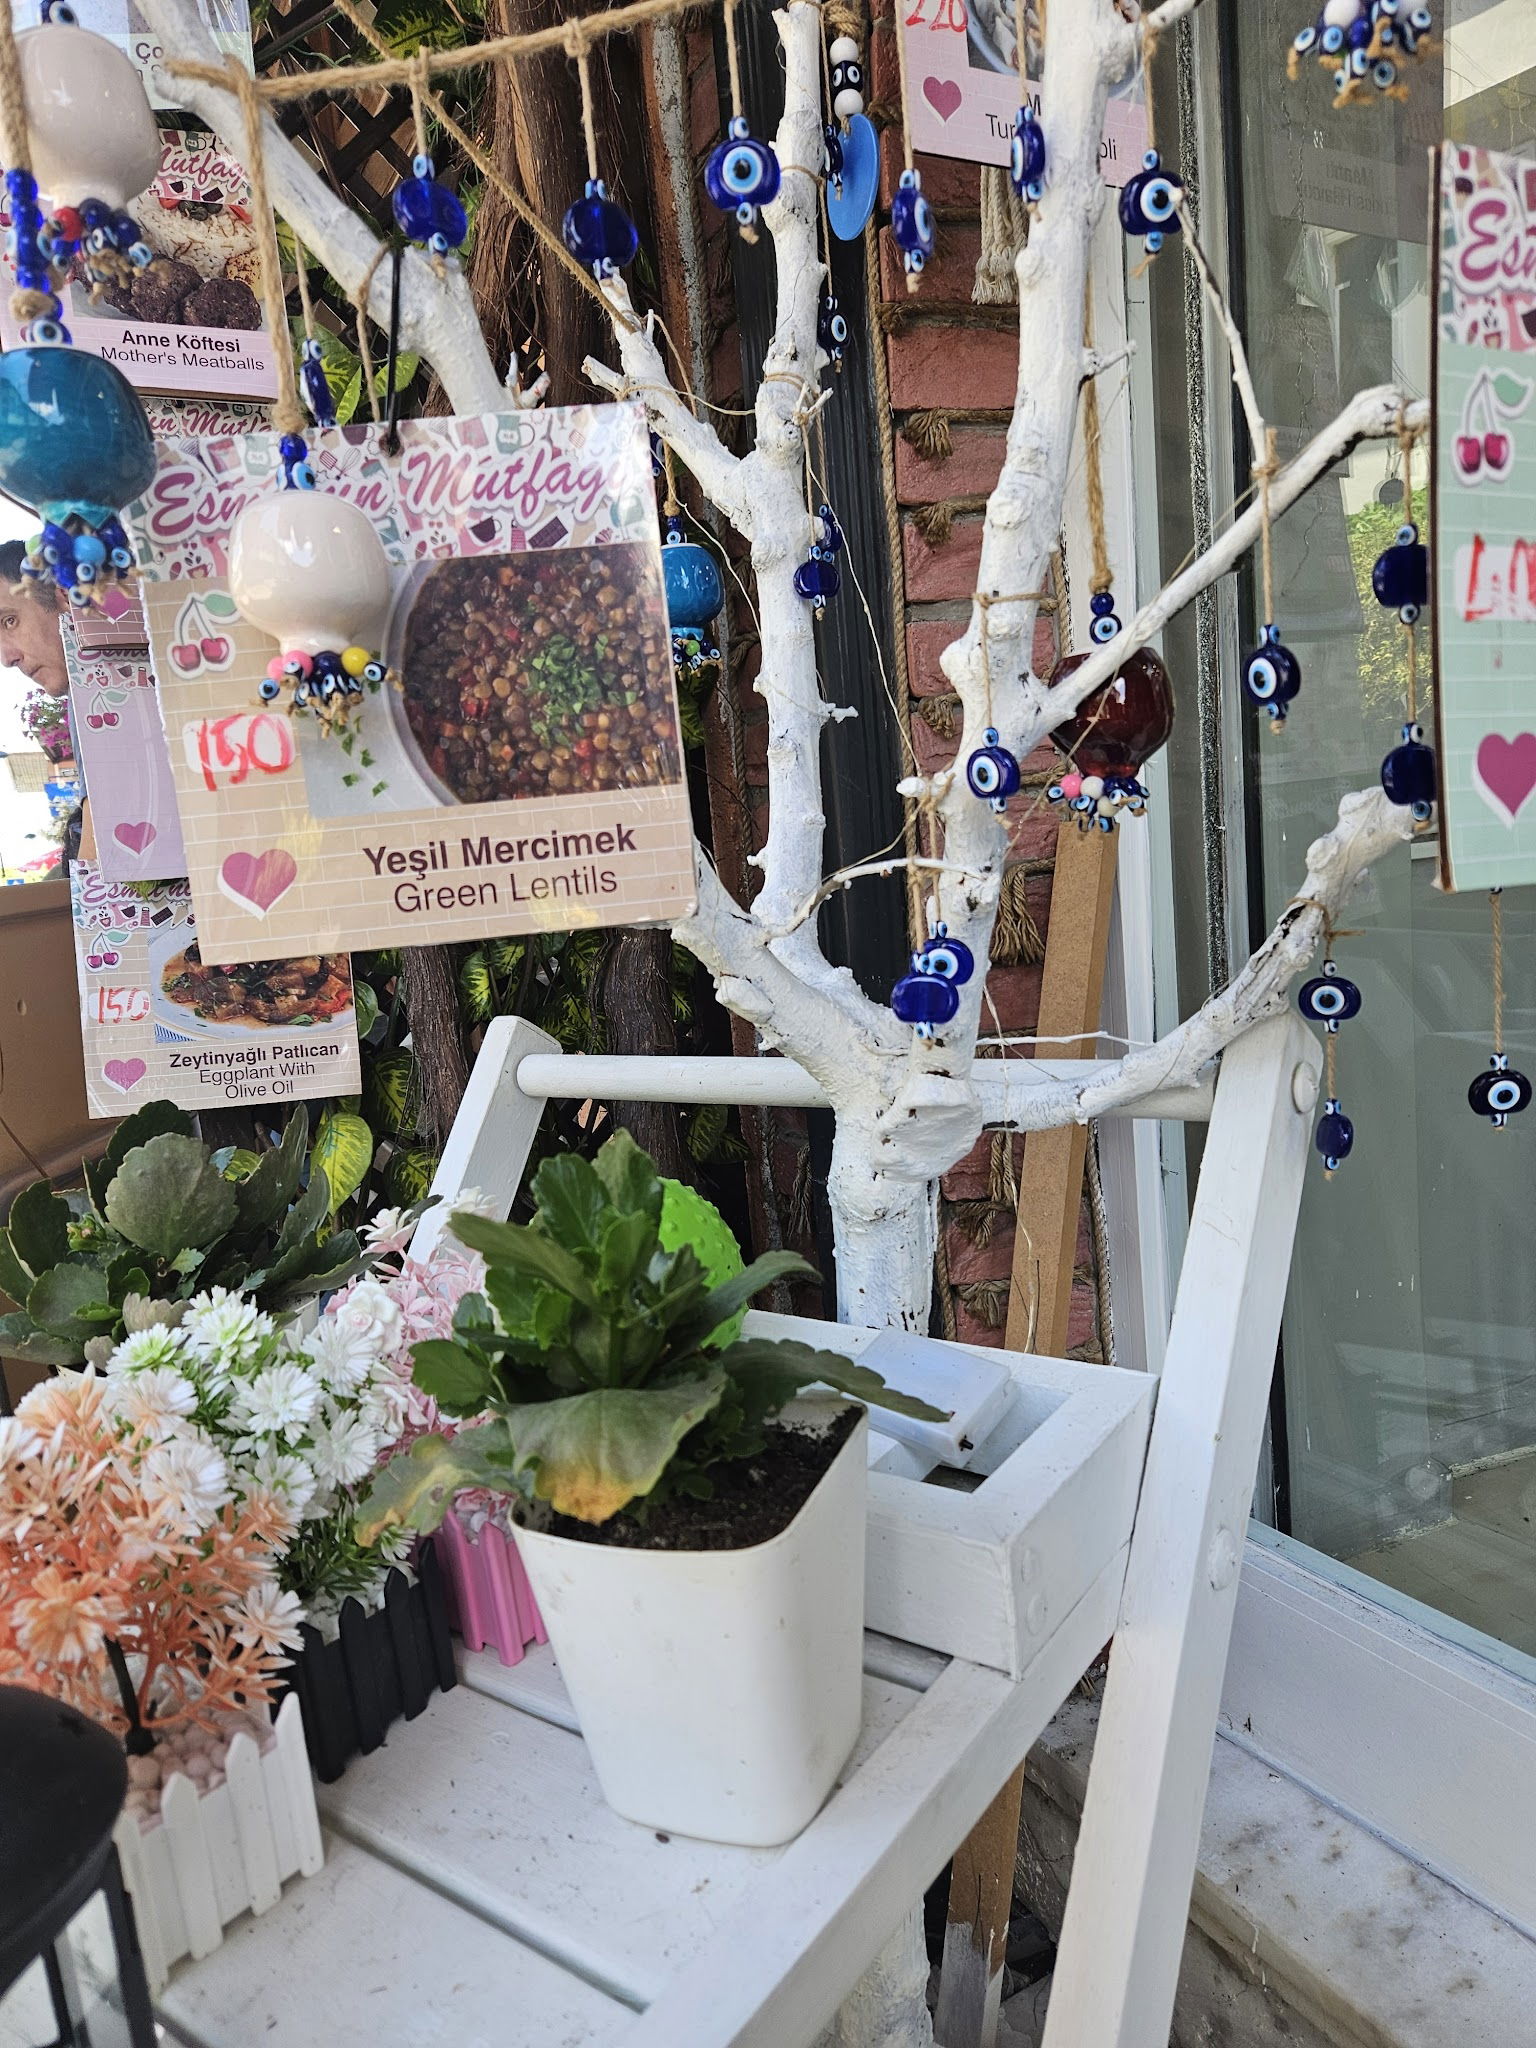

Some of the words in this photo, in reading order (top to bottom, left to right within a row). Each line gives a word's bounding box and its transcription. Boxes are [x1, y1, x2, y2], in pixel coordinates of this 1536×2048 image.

[122, 330, 170, 347] Anne
[176, 333, 241, 353] Köftesi
[101, 346, 177, 365] Mother's
[183, 353, 265, 371] Meatballs
[196, 712, 293, 792] 150
[362, 840, 449, 881] Yeşil
[461, 823, 637, 868] Mercimek
[394, 881, 498, 913] Green
[510, 865, 618, 902] Lentils
[98, 986, 150, 1024] 150
[169, 1047, 267, 1069] Zeytinyağlı
[272, 1043, 339, 1061] Patlıcan
[199, 1063, 275, 1086] Eggplant
[280, 1061, 316, 1076] With
[225, 1082, 267, 1099] Olive
[272, 1080, 294, 1095] Oil
